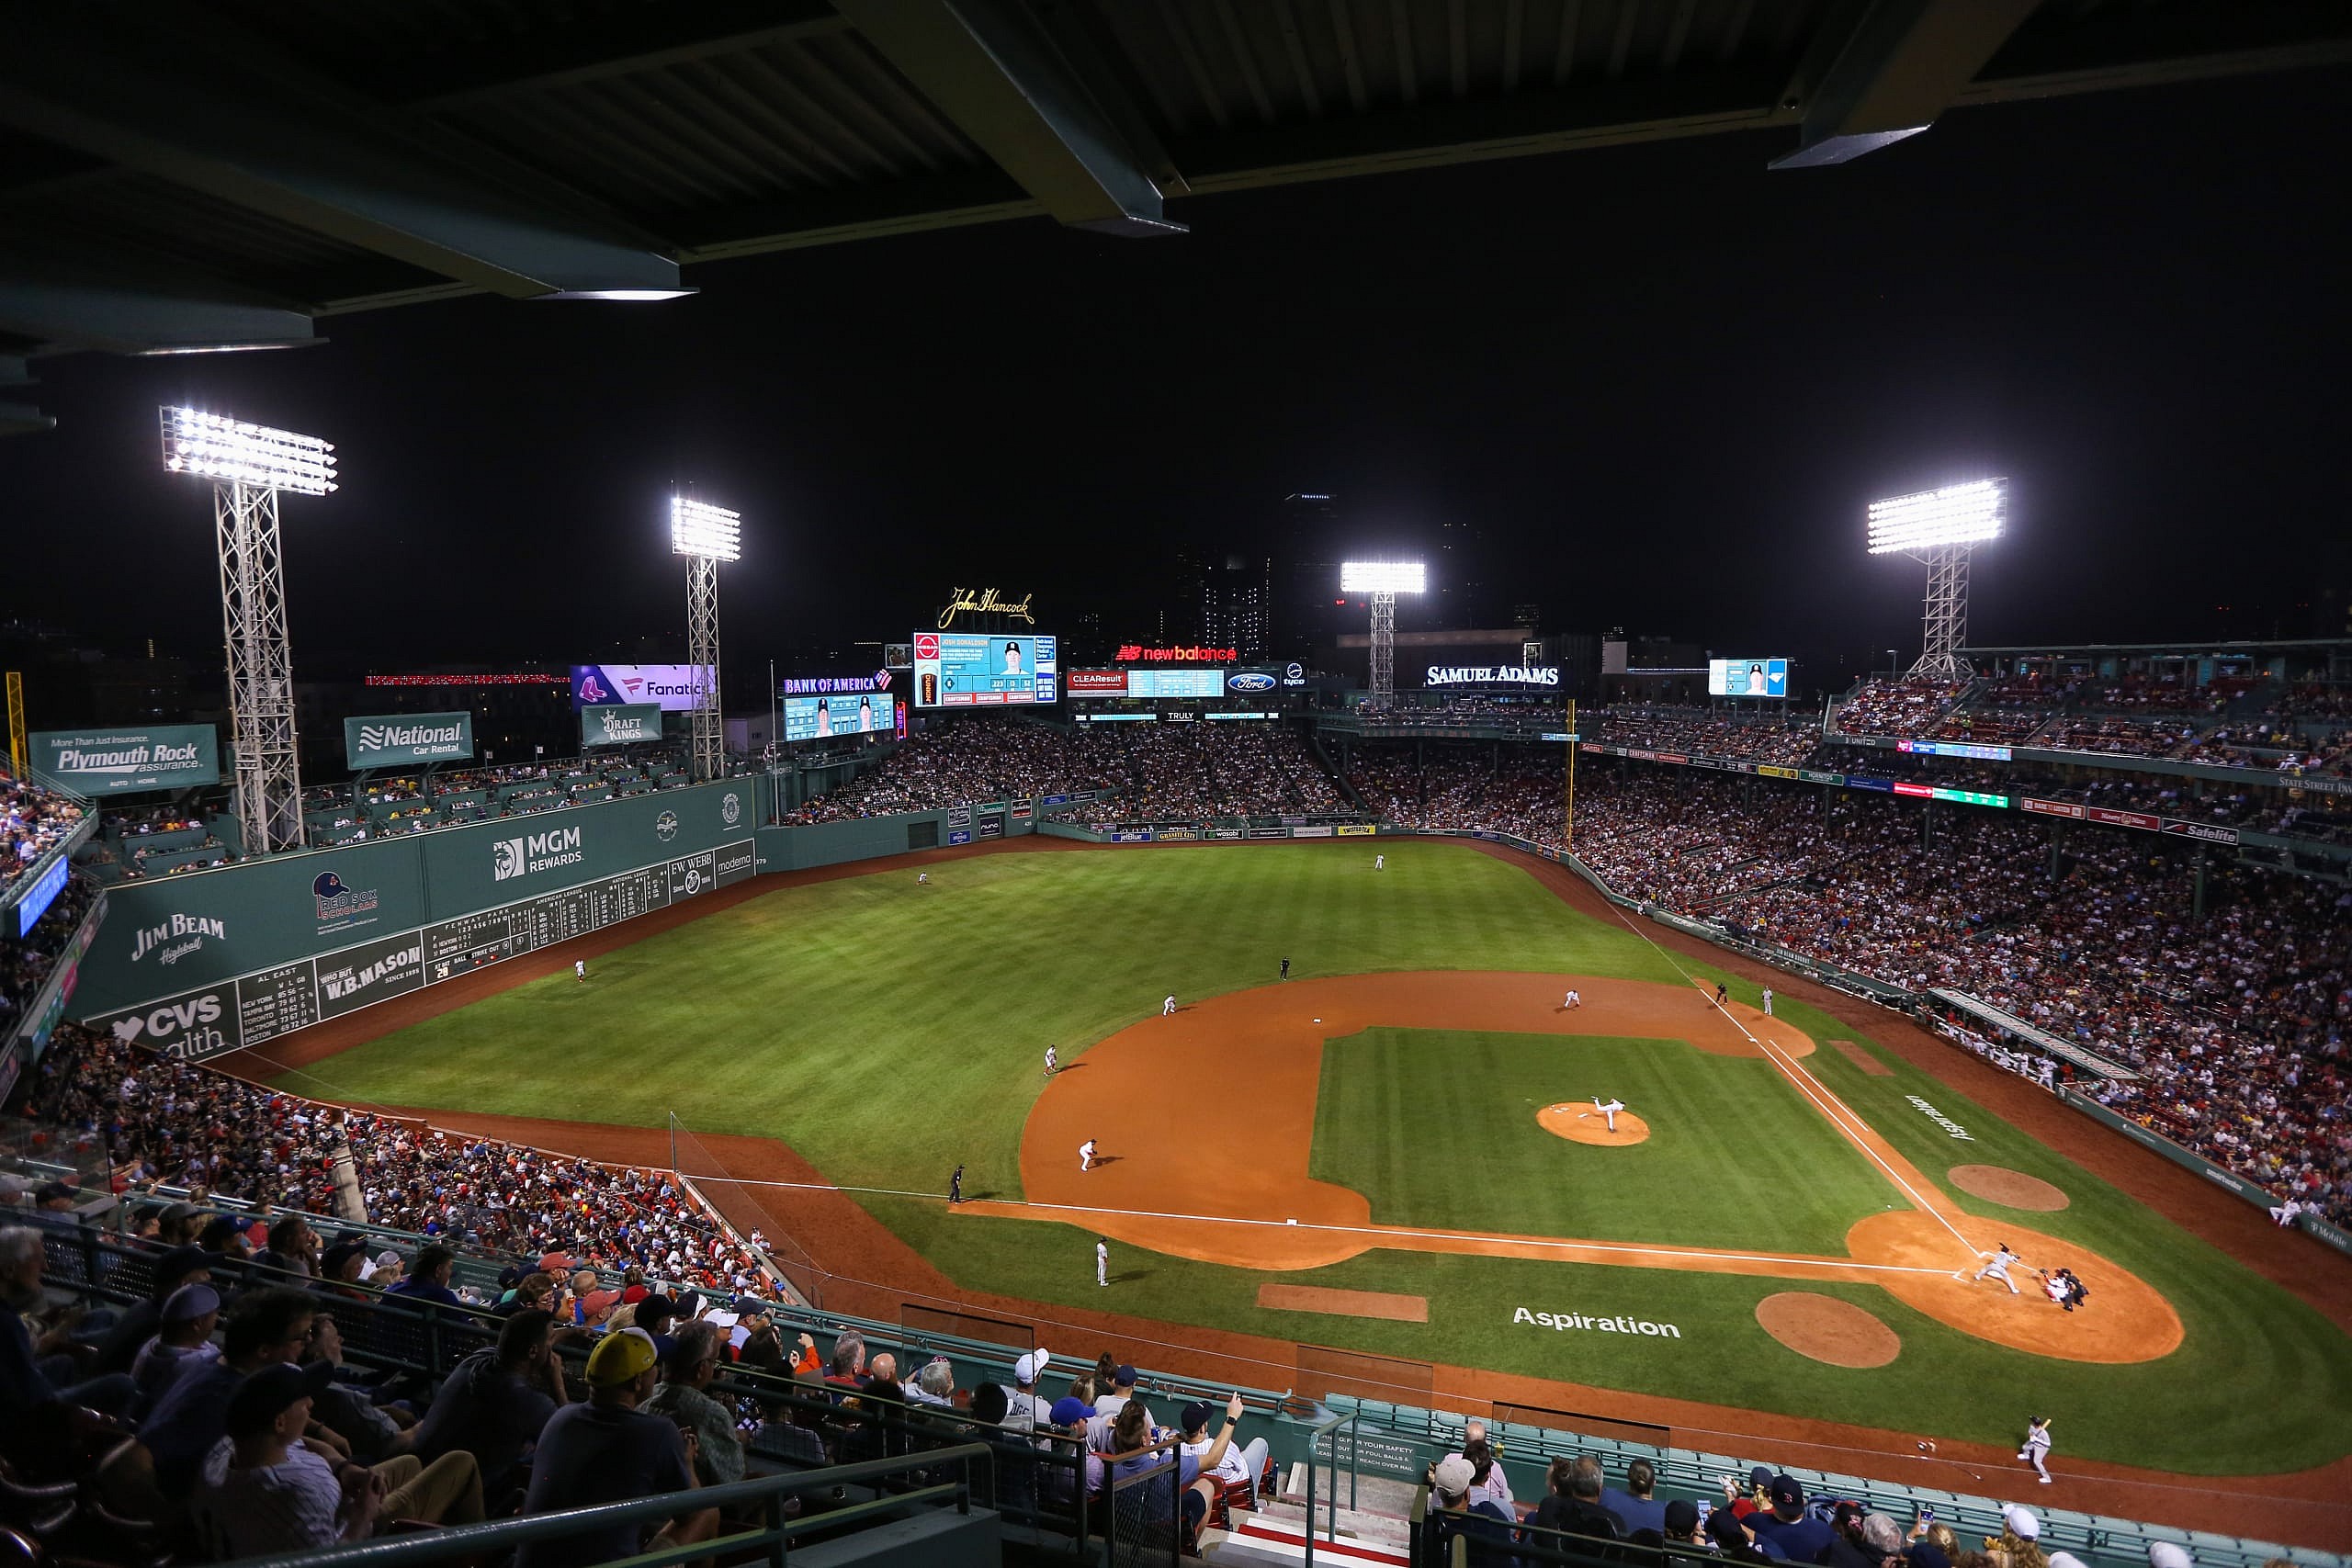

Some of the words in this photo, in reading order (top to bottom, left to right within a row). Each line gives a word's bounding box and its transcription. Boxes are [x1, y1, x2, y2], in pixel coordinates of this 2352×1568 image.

[938, 587, 978, 629] John
[976, 588, 1035, 625] Hancock
[1237, 675, 1266, 689] Ford
[1283, 678, 1305, 686] tyco
[1428, 665, 1496, 685] SAMUEL
[1496, 665, 1558, 685] ADAMS
[786, 679, 818, 694] BANK
[819, 678, 832, 693] OF
[834, 678, 876, 692] AMERICA
[384, 722, 461, 747] National
[605, 718, 641, 733] DRAFT
[610, 728, 641, 741] KINGS
[51, 739, 74, 748] More
[75, 737, 95, 746] Than
[96, 737, 112, 746] Just
[413, 746, 429, 755] Car
[431, 743, 459, 753] Rental
[59, 746, 149, 772] Plymouth
[153, 742, 198, 762] Rock
[140, 759, 199, 773] assurance
[1808, 772, 1834, 781] HORNITOS
[2278, 777, 2304, 788] STATE
[2304, 779, 2335, 792] STREET
[527, 826, 581, 858] MGM
[1121, 833, 1142, 841] jetBlue
[2187, 825, 2236, 843] Safelite
[687, 853, 712, 870] WEBB
[718, 854, 752, 873] moderna
[322, 897, 347, 911] RED
[351, 889, 378, 904] SOX
[537, 894, 562, 905] AMERICAN
[563, 887, 582, 897] LEAGUE
[322, 900, 379, 919] SCHOLARS
[445, 917, 481, 931] FENWAY
[487, 908, 509, 919] PARK
[131, 922, 169, 962] JIM
[171, 913, 226, 940] BEAM
[159, 937, 202, 964] Highball
[439, 944, 458, 955] BOSTON
[454, 955, 467, 964] BALL
[471, 949, 488, 959] STRIKE
[489, 944, 500, 953] OUT
[273, 966, 296, 979] EAST
[320, 972, 338, 985] WHO
[339, 967, 353, 979] BUT
[385, 973, 405, 984] SINCE
[437, 966, 448, 979] 28
[243, 1000, 255, 1009] NEW
[257, 995, 274, 1005] YORK
[277, 990, 287, 998] 85
[147, 994, 221, 1036] CVS
[243, 1007, 263, 1018] TAMPA
[264, 1003, 276, 1011] BAY
[243, 1012, 274, 1025] TORONTO
[279, 1007, 288, 1015] 79
[244, 1019, 278, 1034] BALTIMORE
[301, 1009, 307, 1017] 11
[244, 1029, 272, 1043] BOSTON
[290, 1021, 300, 1029] 72
[1905, 1095, 1975, 1141] Aspiration
[2207, 1168, 2244, 1192] smartwater
[1513, 1306, 1681, 1338] Aspiration
[1363, 1440, 1385, 1450] YOUR
[1385, 1444, 1413, 1453] SAFETY
